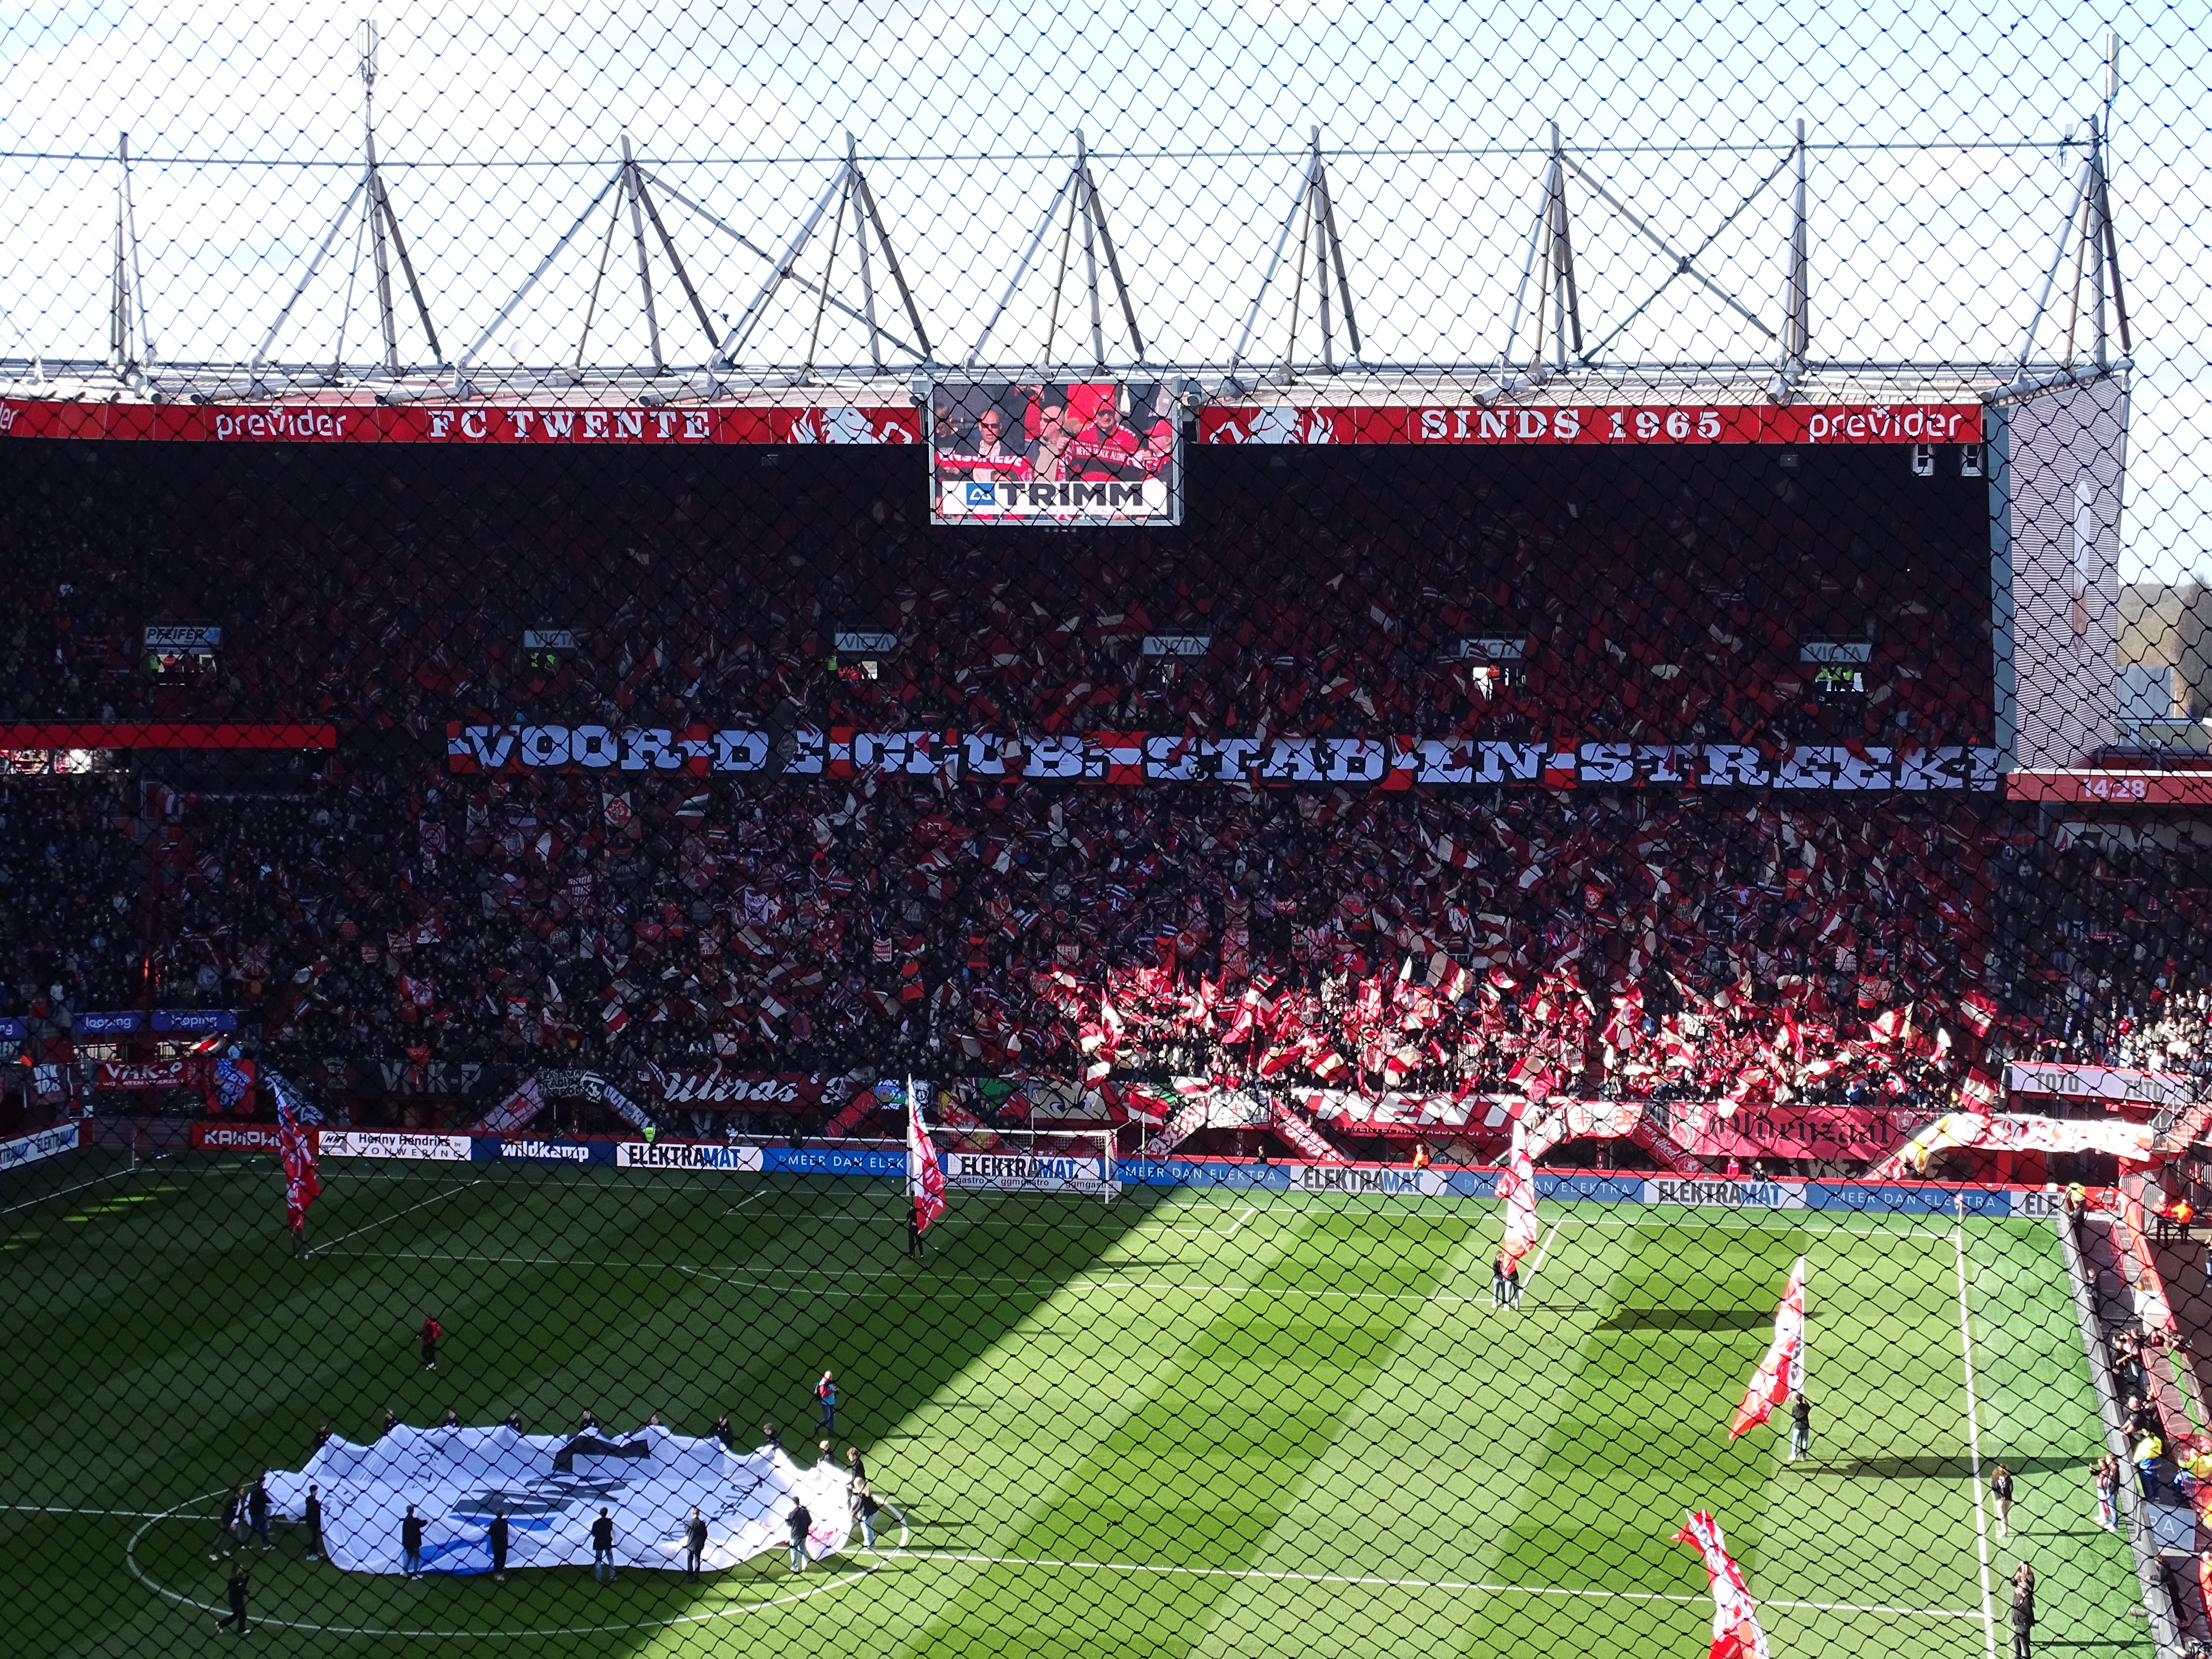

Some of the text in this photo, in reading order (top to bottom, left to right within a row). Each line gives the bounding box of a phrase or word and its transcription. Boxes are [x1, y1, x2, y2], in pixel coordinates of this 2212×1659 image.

[216, 406, 346, 440] previder
[428, 410, 710, 439] FC TWENTE
[1421, 408, 1721, 439] SINDS 1965
[1809, 405, 1962, 443] previder
[998, 483, 1143, 506] TRIMM
[146, 628, 204, 640] PFEIFER
[466, 724, 682, 770] VOOR
[1417, 738, 1548, 783] EN
[2083, 778, 2145, 798] 14:28
[85, 1015, 131, 1029] looping
[172, 1014, 217, 1027] looping
[2037, 1072, 2079, 1093] TOTO
[2124, 1079, 2163, 1101] TOTO
[359, 1134, 395, 1145] Henny
[399, 1135, 451, 1147] Hendriks
[501, 1140, 589, 1162] wildkamp
[629, 1145, 741, 1168] ELEKTRAMAT
[788, 1155, 904, 1169] MEER DAN ELEK
[961, 1156, 1077, 1179] ELEKTRAMAT
[1125, 1166, 1276, 1182] MEER DAN ELEKTRA
[1304, 1169, 1423, 1193] ELEKTRAMAT
[1562, 1182, 1630, 1194] ELEKTRA
[1658, 1181, 1782, 1205] ELEKTRAMAT
[1834, 1192, 1876, 1203] MEER
[1884, 1193, 1916, 1205] DAN
